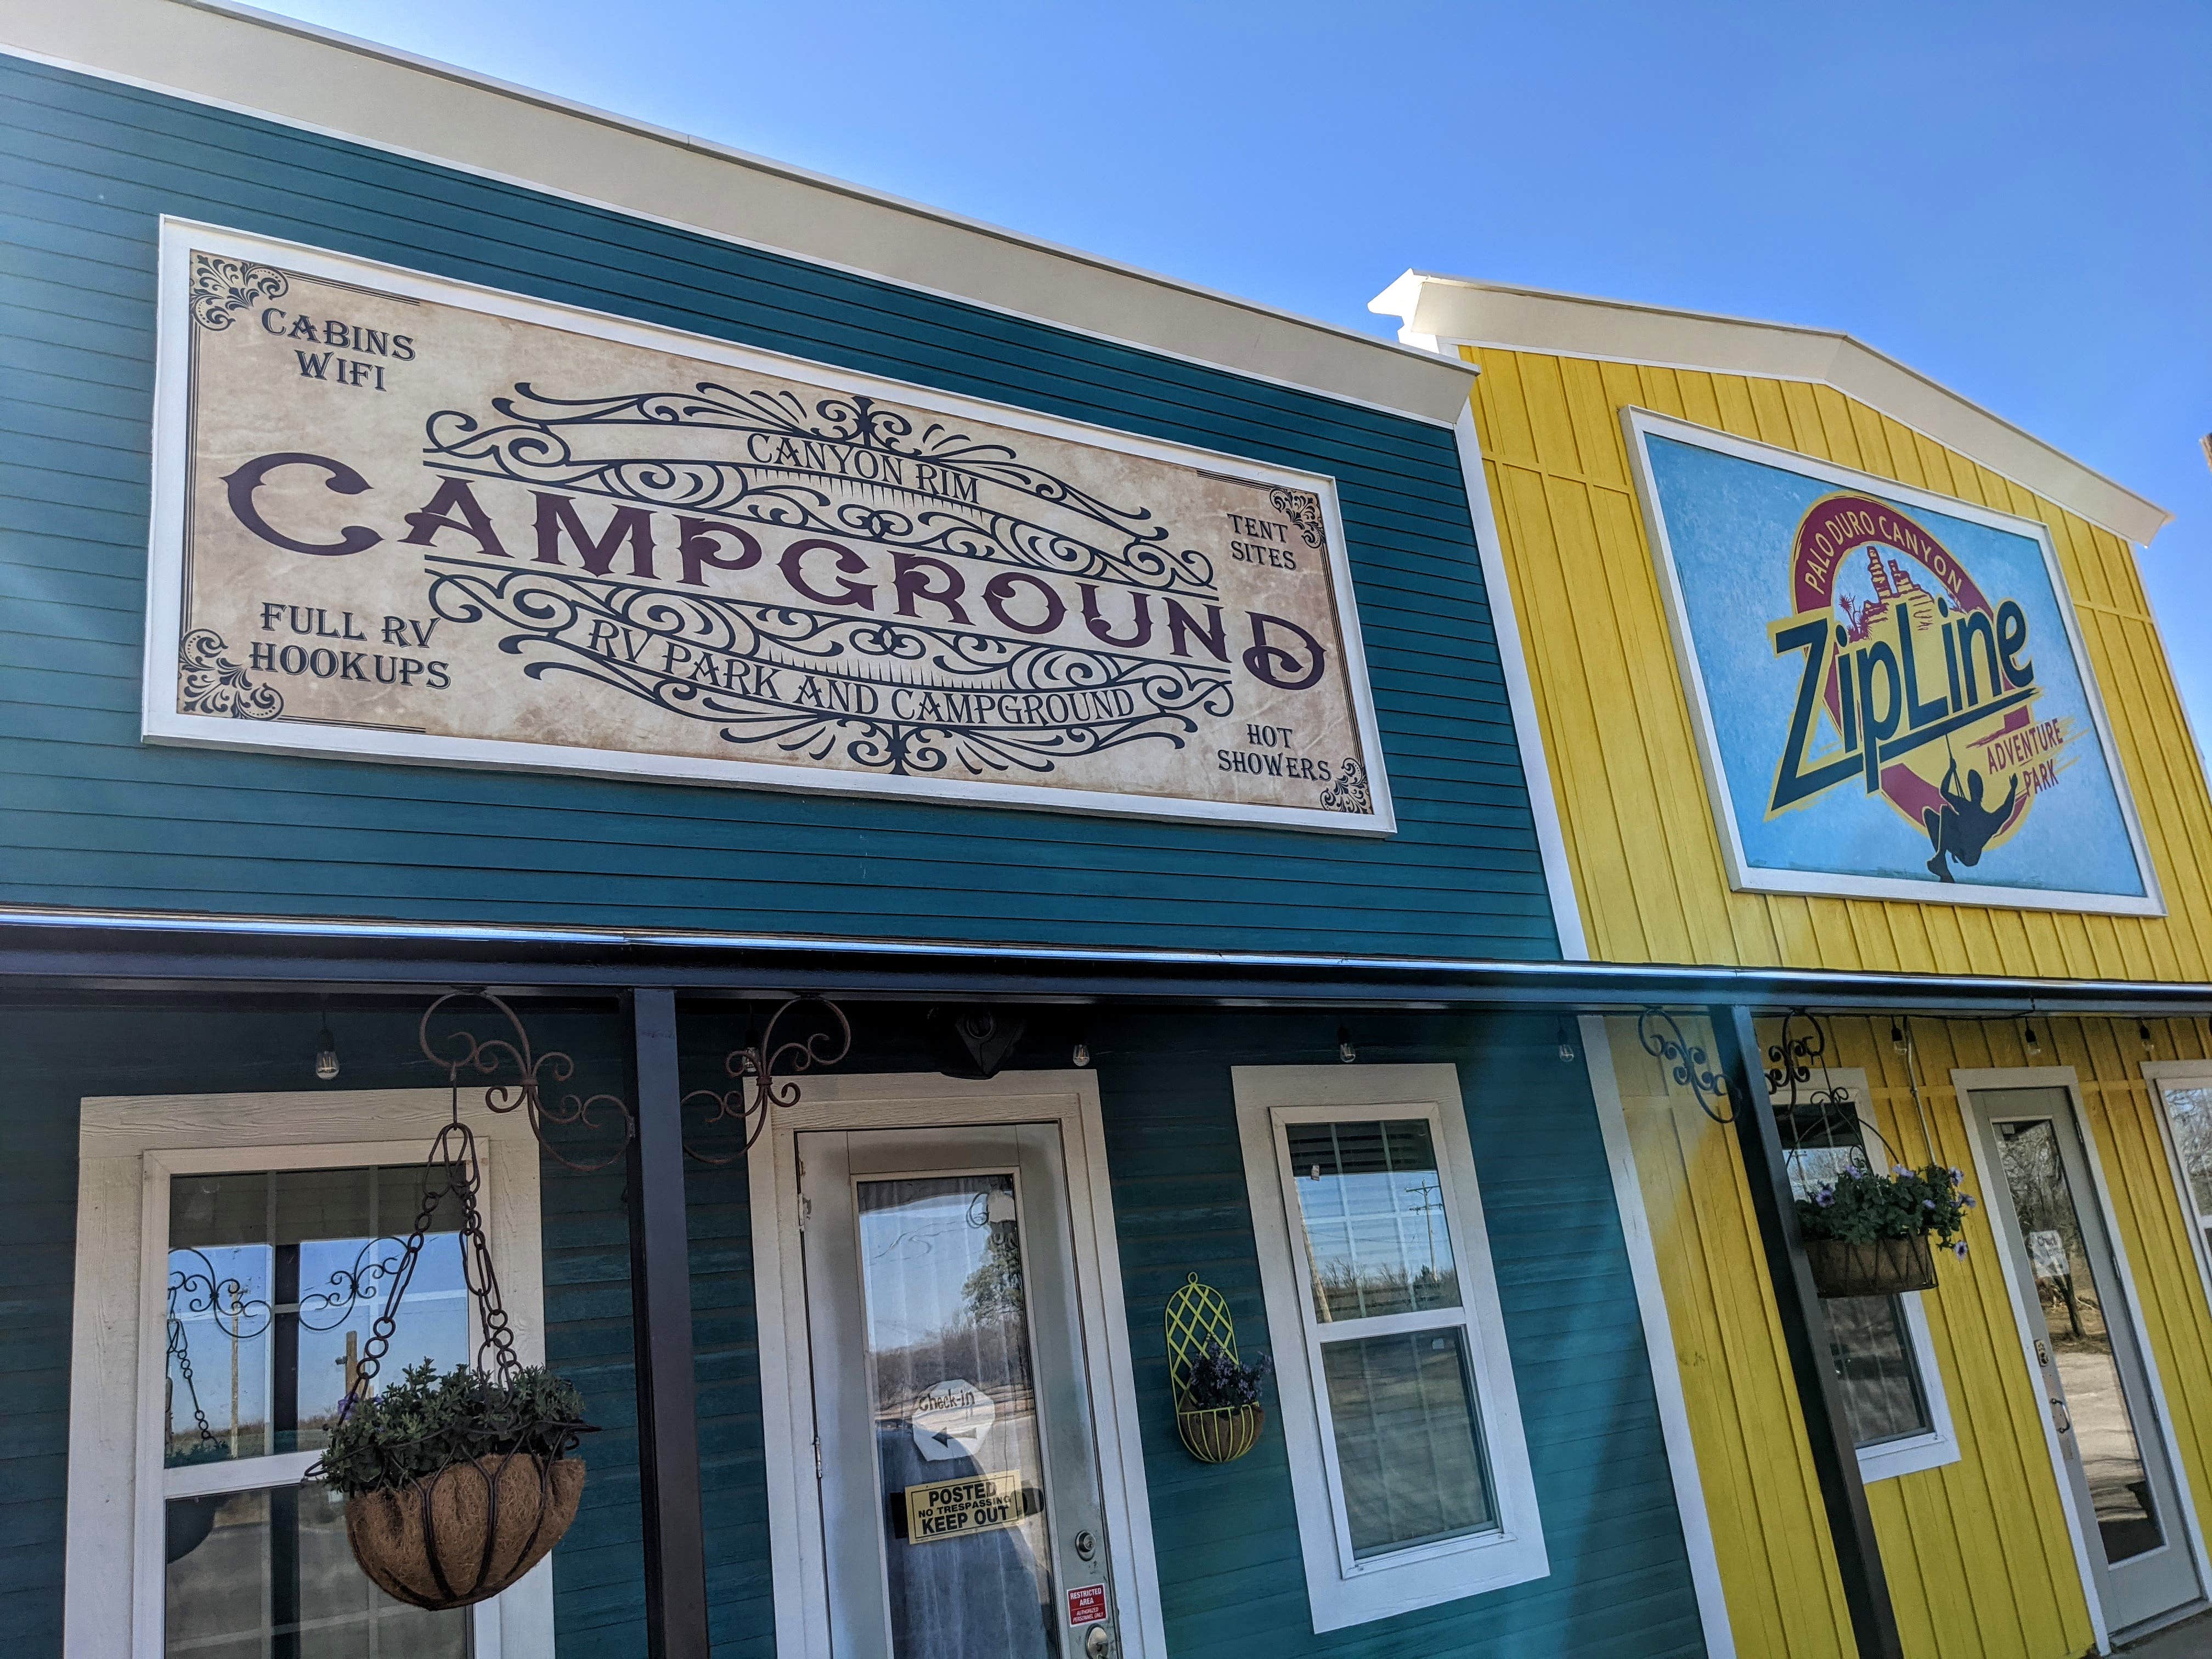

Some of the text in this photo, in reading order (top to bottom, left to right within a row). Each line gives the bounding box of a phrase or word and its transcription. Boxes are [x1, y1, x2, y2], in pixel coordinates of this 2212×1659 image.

[261, 307, 416, 362] CABINS
[294, 349, 387, 392] WIFI
[747, 433, 980, 505] CANYON RIM
[1227, 514, 1288, 543] TENT
[1231, 540, 1296, 571] SITES
[1804, 511, 1962, 594] PALO DURO CANYON
[219, 452, 1327, 690] CAMPGROUND
[261, 602, 441, 649] FULL RV
[249, 641, 451, 690] HOOKUPS
[588, 619, 1134, 726] RV PARK AND CAMPGROUND
[1771, 597, 2034, 811] ZipLine
[1246, 724, 1294, 749] HOT
[1986, 718, 2063, 774] ADVENTURE
[1217, 749, 1332, 782] SHOWERS
[2023, 764, 2059, 798] PARK
[918, 1389, 975, 1412] Check-in
[918, 1509, 933, 1518] NO
[936, 1495, 1011, 1514] TRESPASSING
[929, 1481, 997, 1507] POSTED
[922, 1513, 968, 1535] KEEP
[974, 1505, 1009, 1525] OUT
[1070, 1588, 1102, 1600] RESTRICTED
[1080, 1597, 1094, 1606] AREA
[1073, 1614, 1093, 1623] PERSONNEL
[1076, 1607, 1099, 1616] AUTHORIZED
